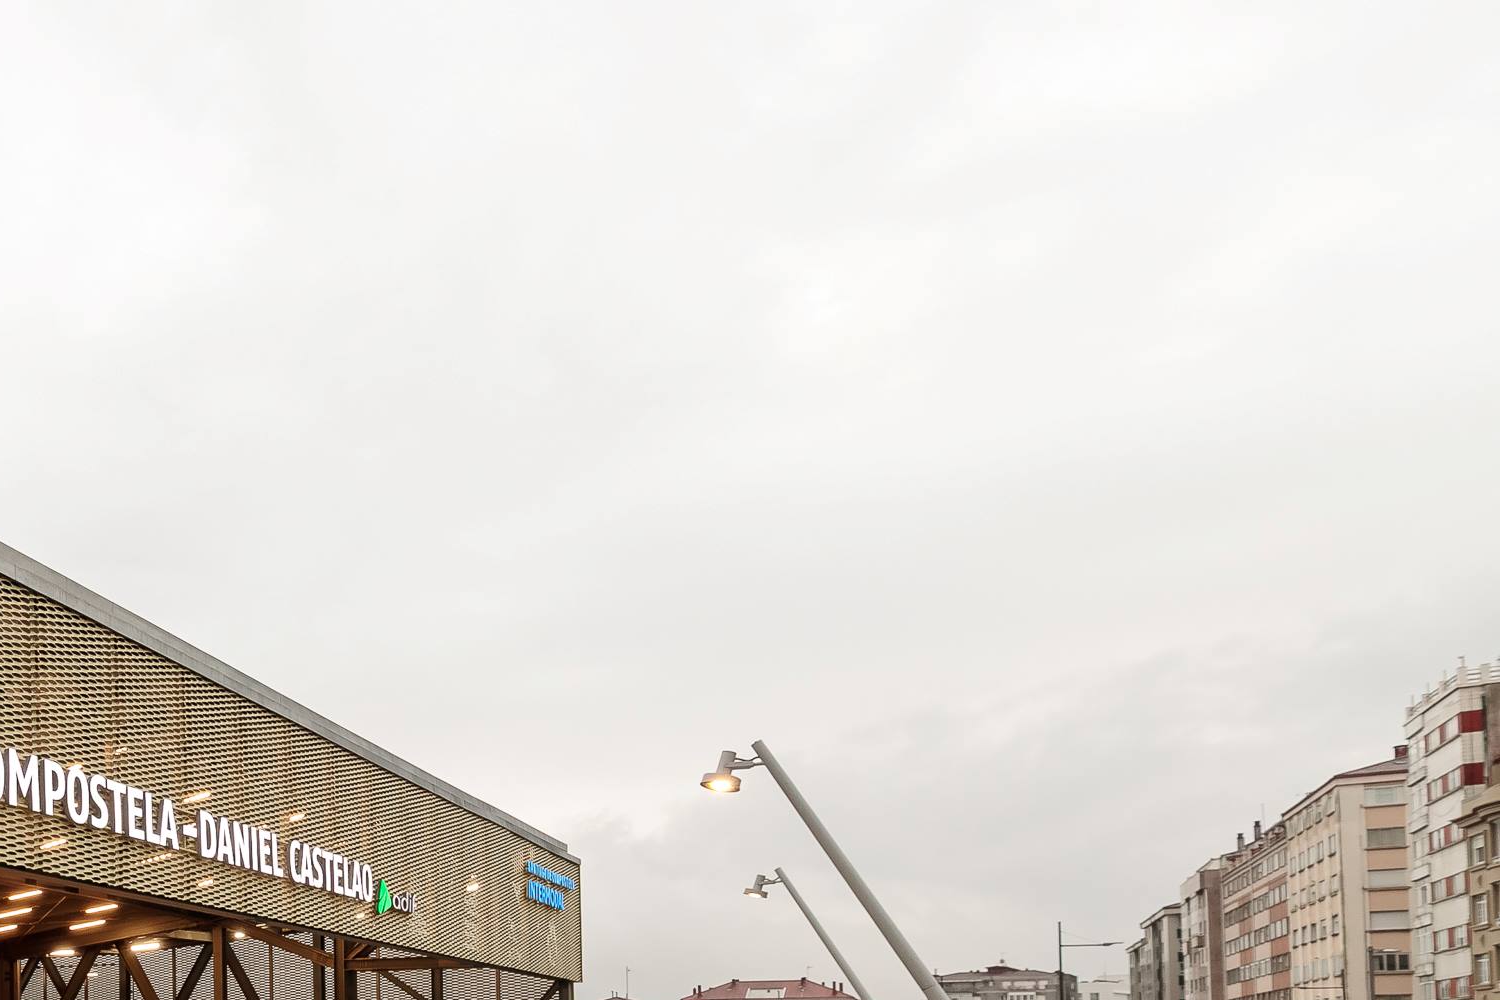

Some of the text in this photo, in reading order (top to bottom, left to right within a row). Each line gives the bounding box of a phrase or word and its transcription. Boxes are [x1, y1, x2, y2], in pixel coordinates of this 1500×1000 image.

[288, 839, 373, 903] CASTELAO
[392, 891, 417, 913] adif
[526, 879, 565, 911] INTERMODAL
